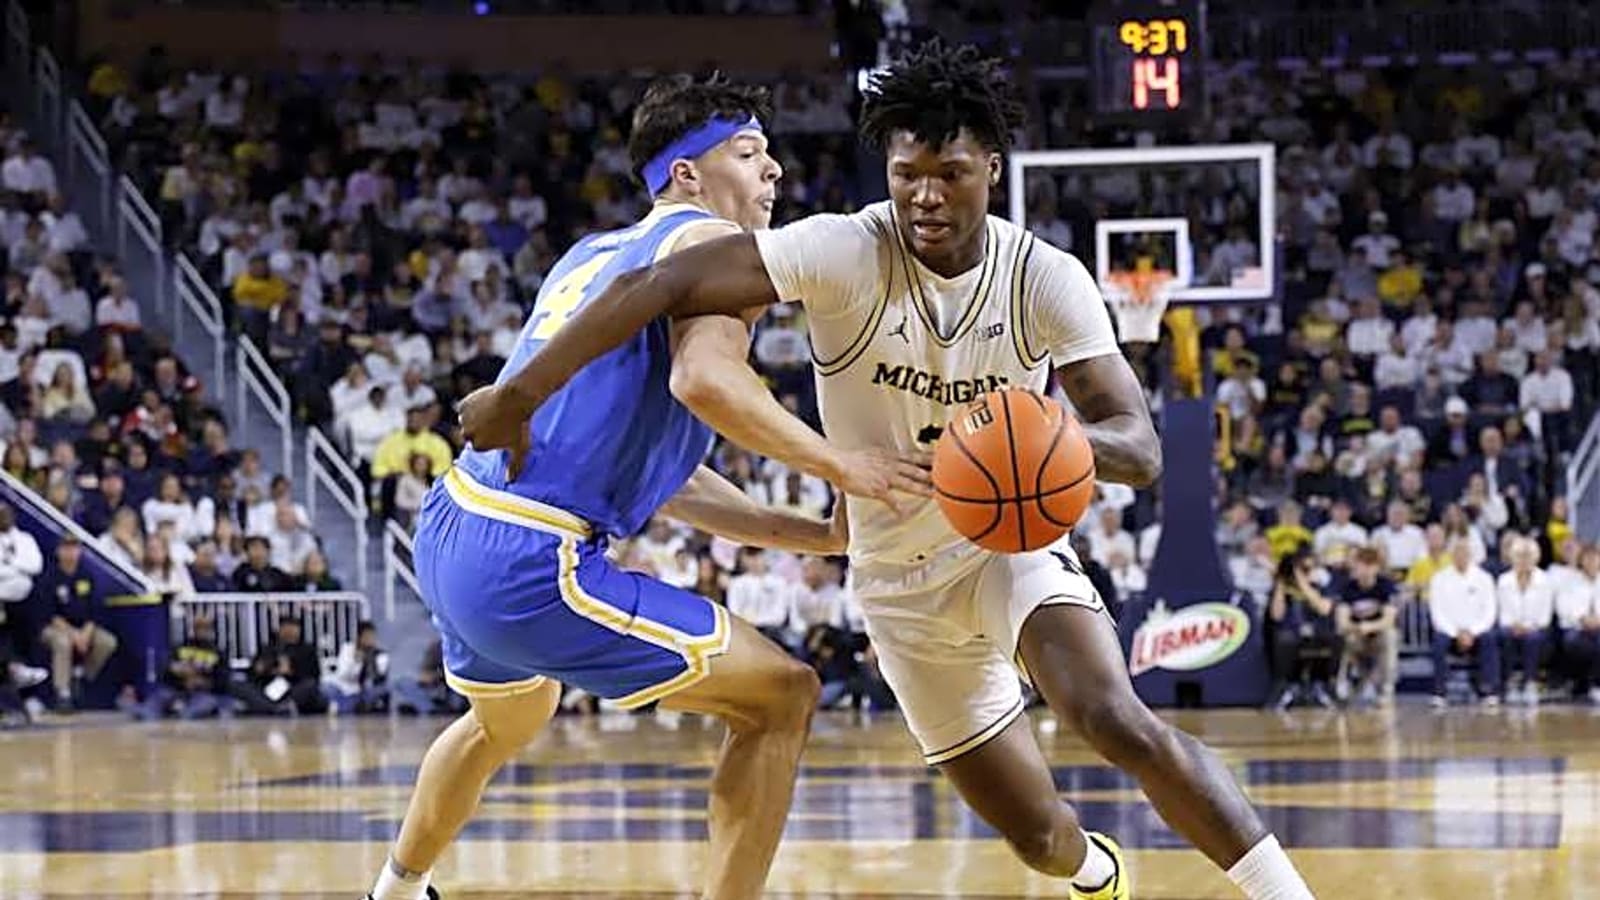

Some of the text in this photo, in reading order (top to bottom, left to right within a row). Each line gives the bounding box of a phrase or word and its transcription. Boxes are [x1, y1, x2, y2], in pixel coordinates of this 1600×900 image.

[1120, 19, 1187, 55] 9:37
[1133, 57, 1179, 109] 14
[1132, 617, 1238, 669] LIBMAN
